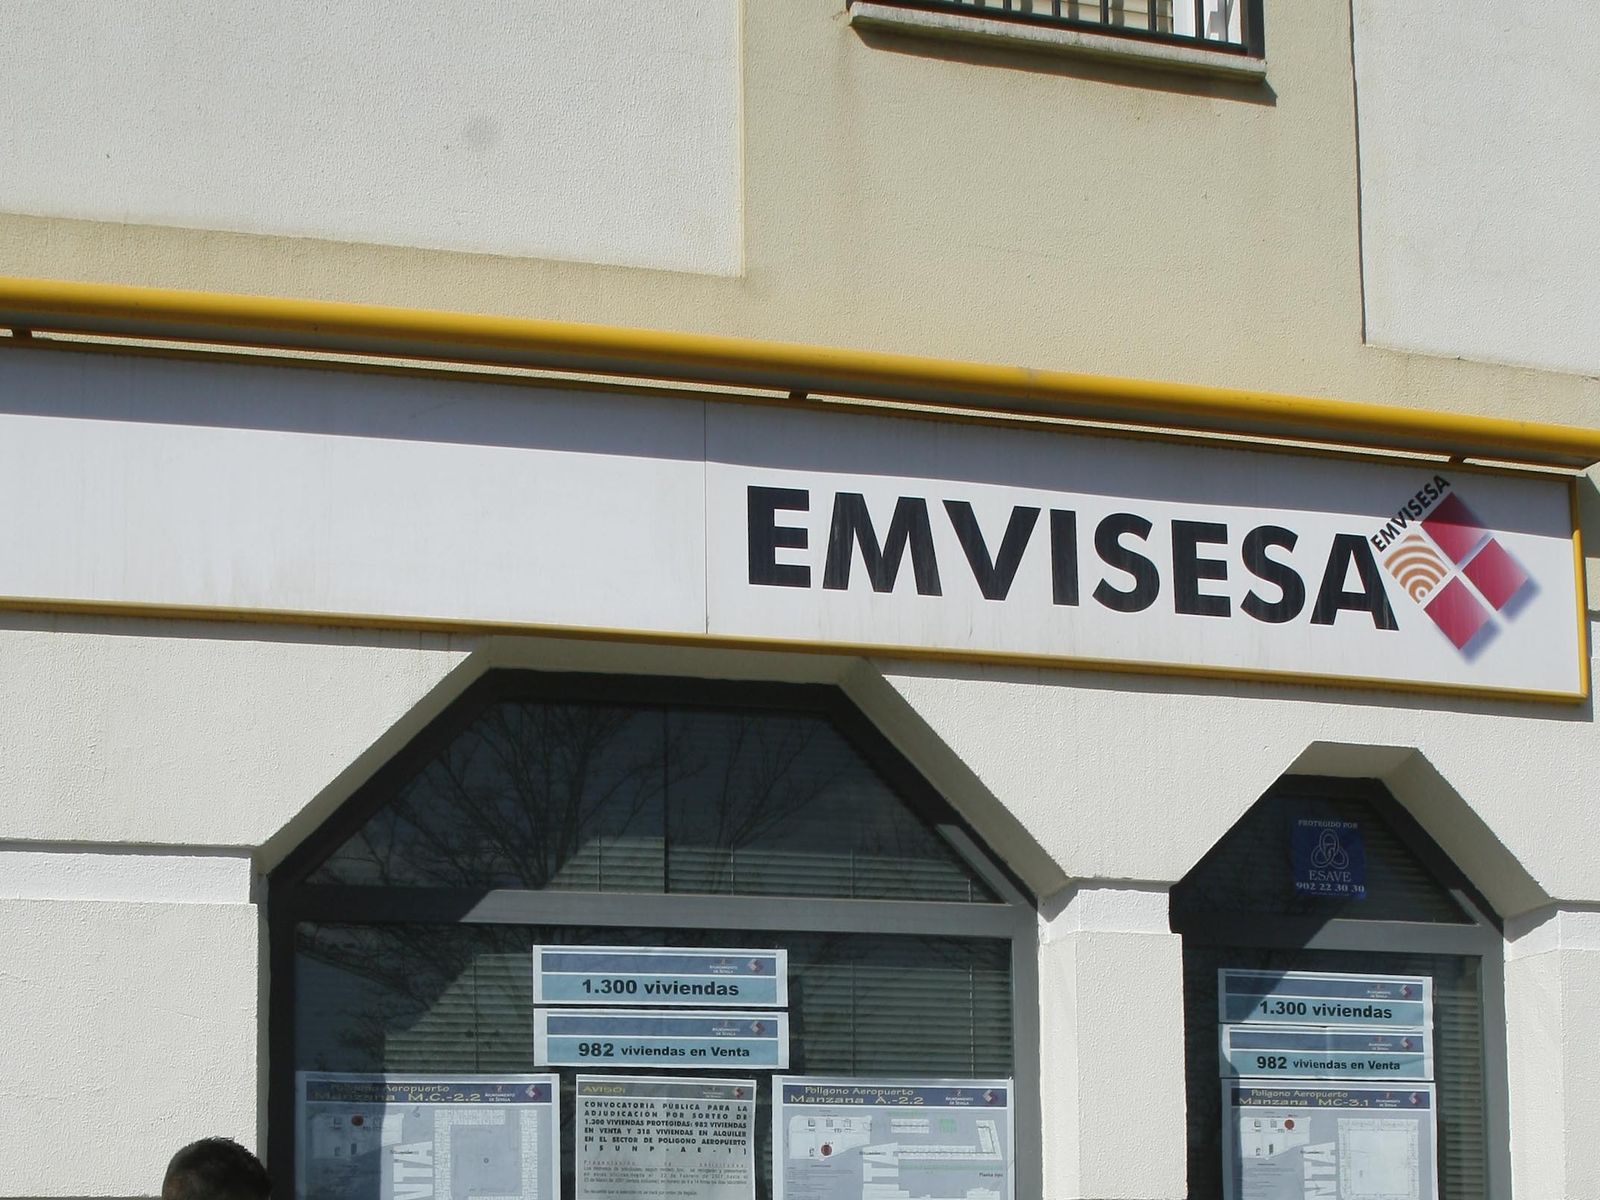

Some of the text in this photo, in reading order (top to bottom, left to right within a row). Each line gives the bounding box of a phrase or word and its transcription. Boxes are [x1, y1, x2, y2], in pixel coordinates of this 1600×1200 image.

[1370, 475, 1451, 552] EMVISESA
[747, 485, 1399, 631] EMVISESA
[1298, 820, 1341, 828] PROTEGIDO
[1309, 870, 1352, 883] ESAVE
[1296, 882, 1365, 893] 902 22 30 30
[582, 979, 740, 996] 1.300 viviendas
[1259, 1001, 1393, 1019] 1.300 viviendas
[578, 1042, 750, 1058] 982 viviendas en Venta
[1257, 1056, 1400, 1071] 982 viviendas en Venta
[384, 1084, 450, 1093] Aeropuerto
[852, 1087, 914, 1096] Aeropuerto
[407, 1093, 482, 1102] M.C.-2.2
[1293, 1090, 1349, 1099] Aeropuerto
[584, 1101, 655, 1109] CONVOCATORIA
[790, 1095, 925, 1105] Manzana A.-2.2
[1239, 1097, 1369, 1107] Manzana MC-3.1
[666, 1111, 685, 1119] POR
[710, 1121, 747, 1129] VIVIENDAS
[701, 1138, 747, 1146] AEROPUERTO
